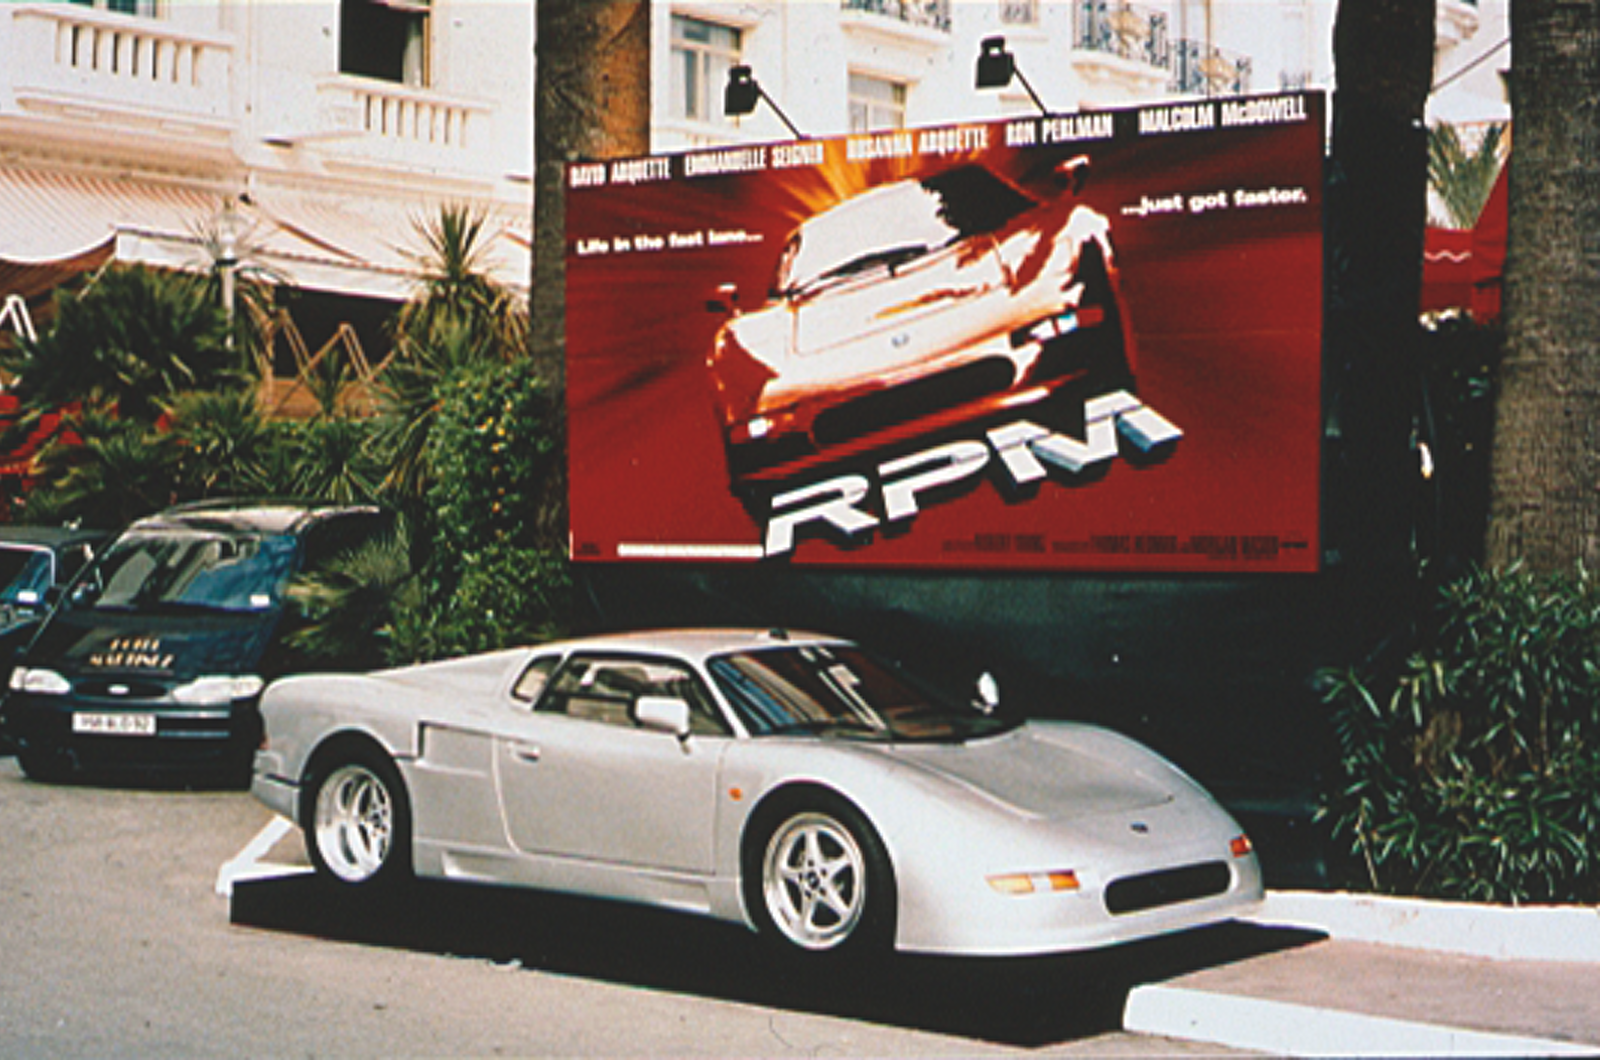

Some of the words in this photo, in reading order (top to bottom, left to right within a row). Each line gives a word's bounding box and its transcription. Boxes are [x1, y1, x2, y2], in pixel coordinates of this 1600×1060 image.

[611, 157, 671, 185] ARQUETTE
[918, 124, 988, 158] ARQUETTE
[1006, 120, 1036, 147] RON
[1042, 115, 1113, 144] PERLMAN
[1138, 103, 1216, 134] MALCOLM
[1221, 95, 1307, 127] McDOWELL
[1188, 190, 1229, 213] got
[1234, 186, 1308, 207] faster.
[576, 237, 610, 255] Life
[614, 235, 631, 252] in
[634, 233, 665, 251] the
[668, 230, 704, 249] fast
[766, 390, 1184, 557] RPM
